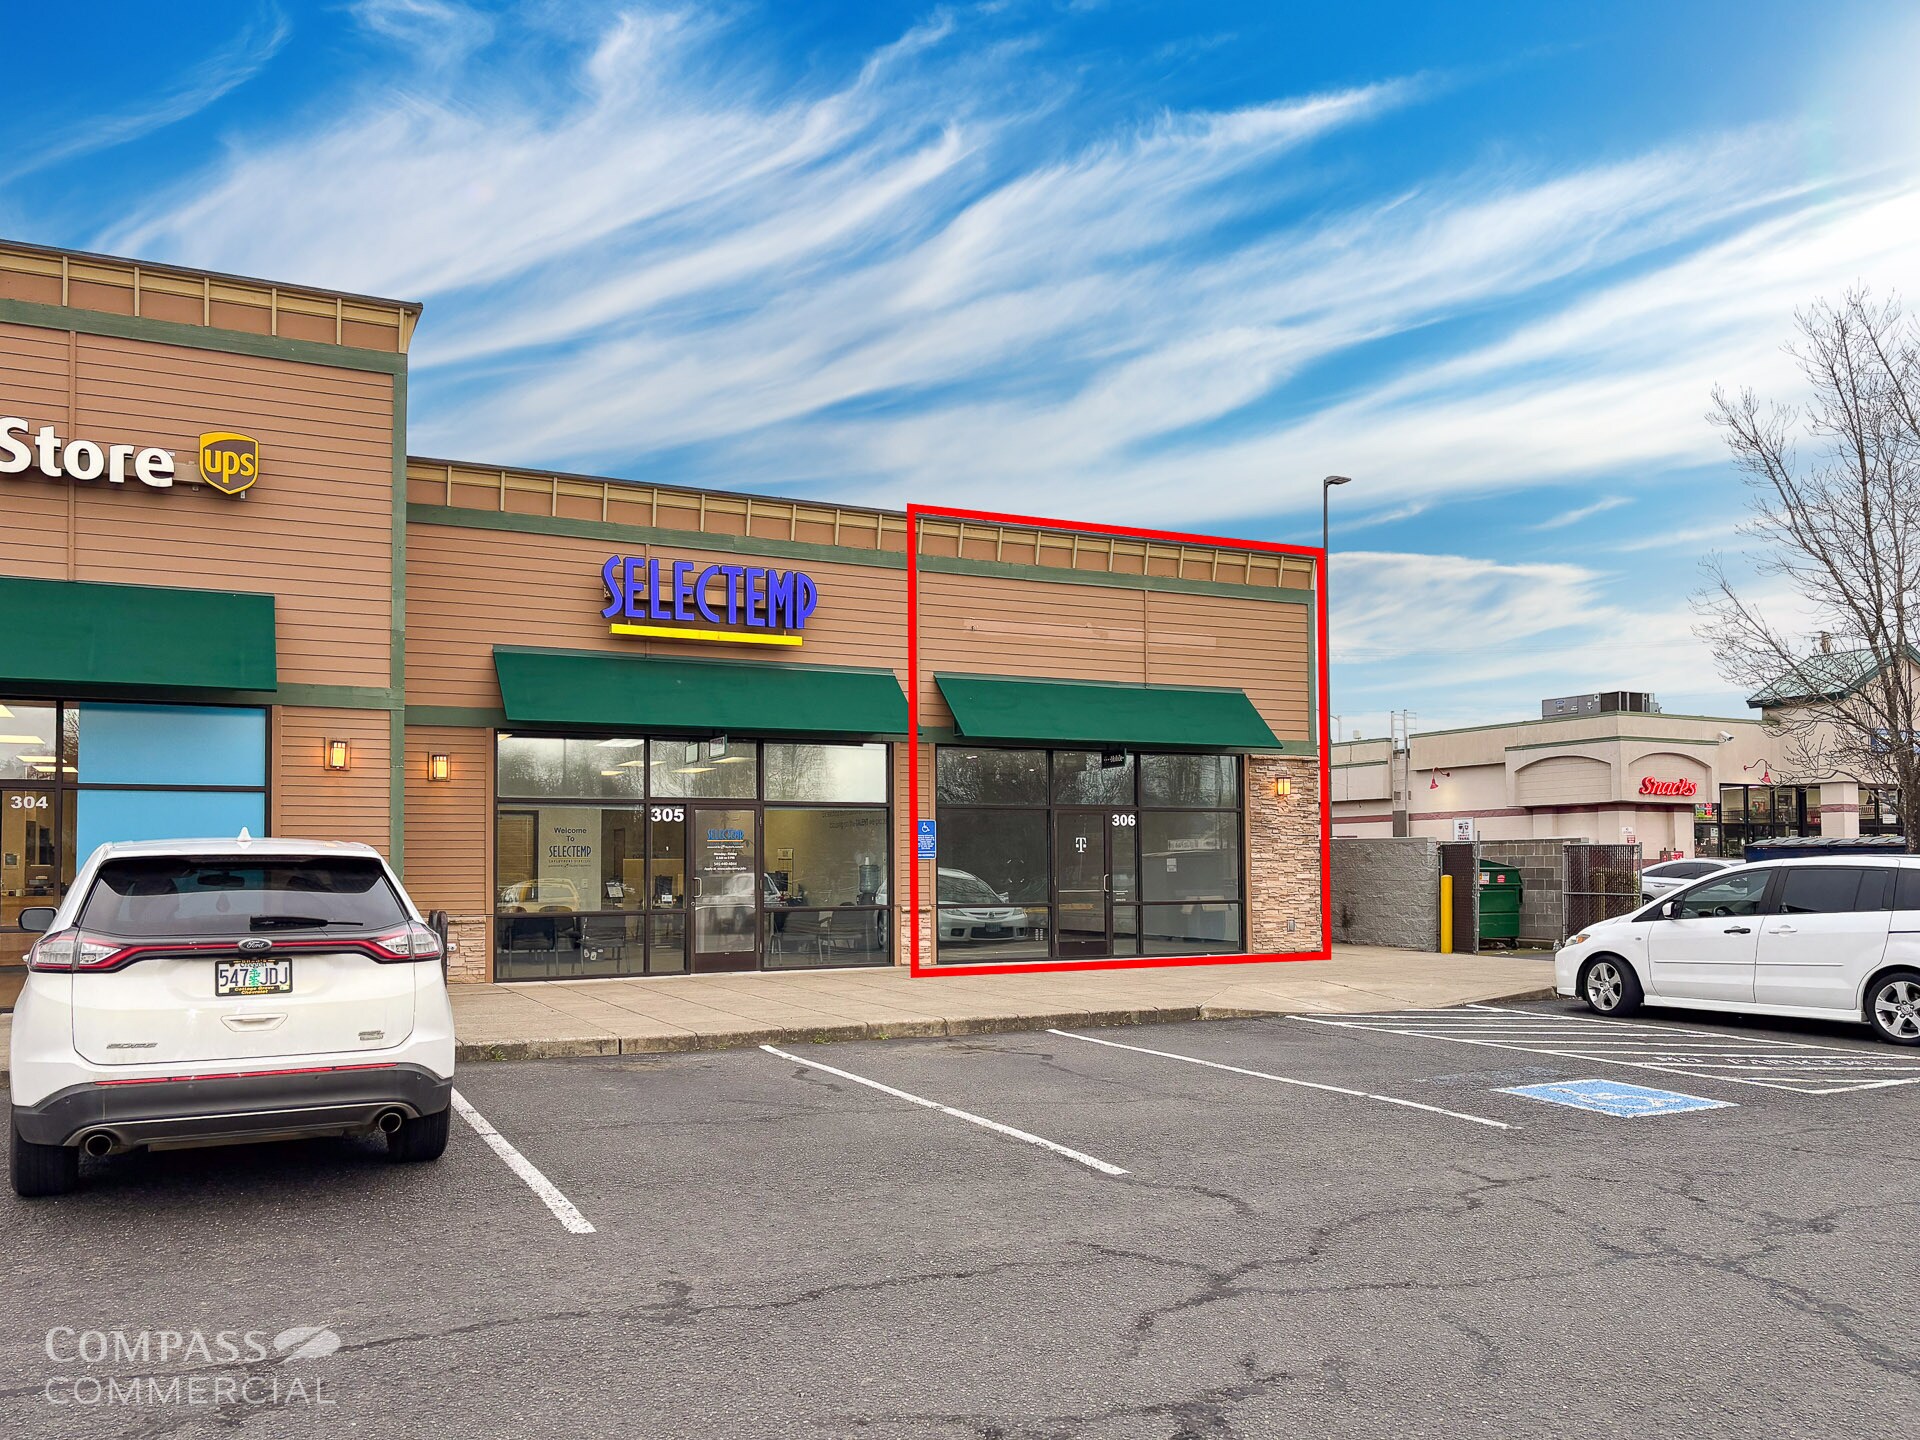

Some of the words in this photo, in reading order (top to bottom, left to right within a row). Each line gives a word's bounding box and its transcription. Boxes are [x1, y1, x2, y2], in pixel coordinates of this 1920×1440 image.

[0, 417, 175, 487] Store
[204, 449, 255, 484] ups
[602, 555, 817, 629] SELECTEMP
[1639, 776, 1698, 796] Snacks
[11, 796, 48, 809] 304
[650, 808, 685, 822] 305
[1112, 814, 1136, 827] 306
[548, 845, 592, 858] SELECTEMP
[246, 941, 265, 949] Ford
[219, 968, 249, 987] 547
[259, 966, 288, 985] JDJ
